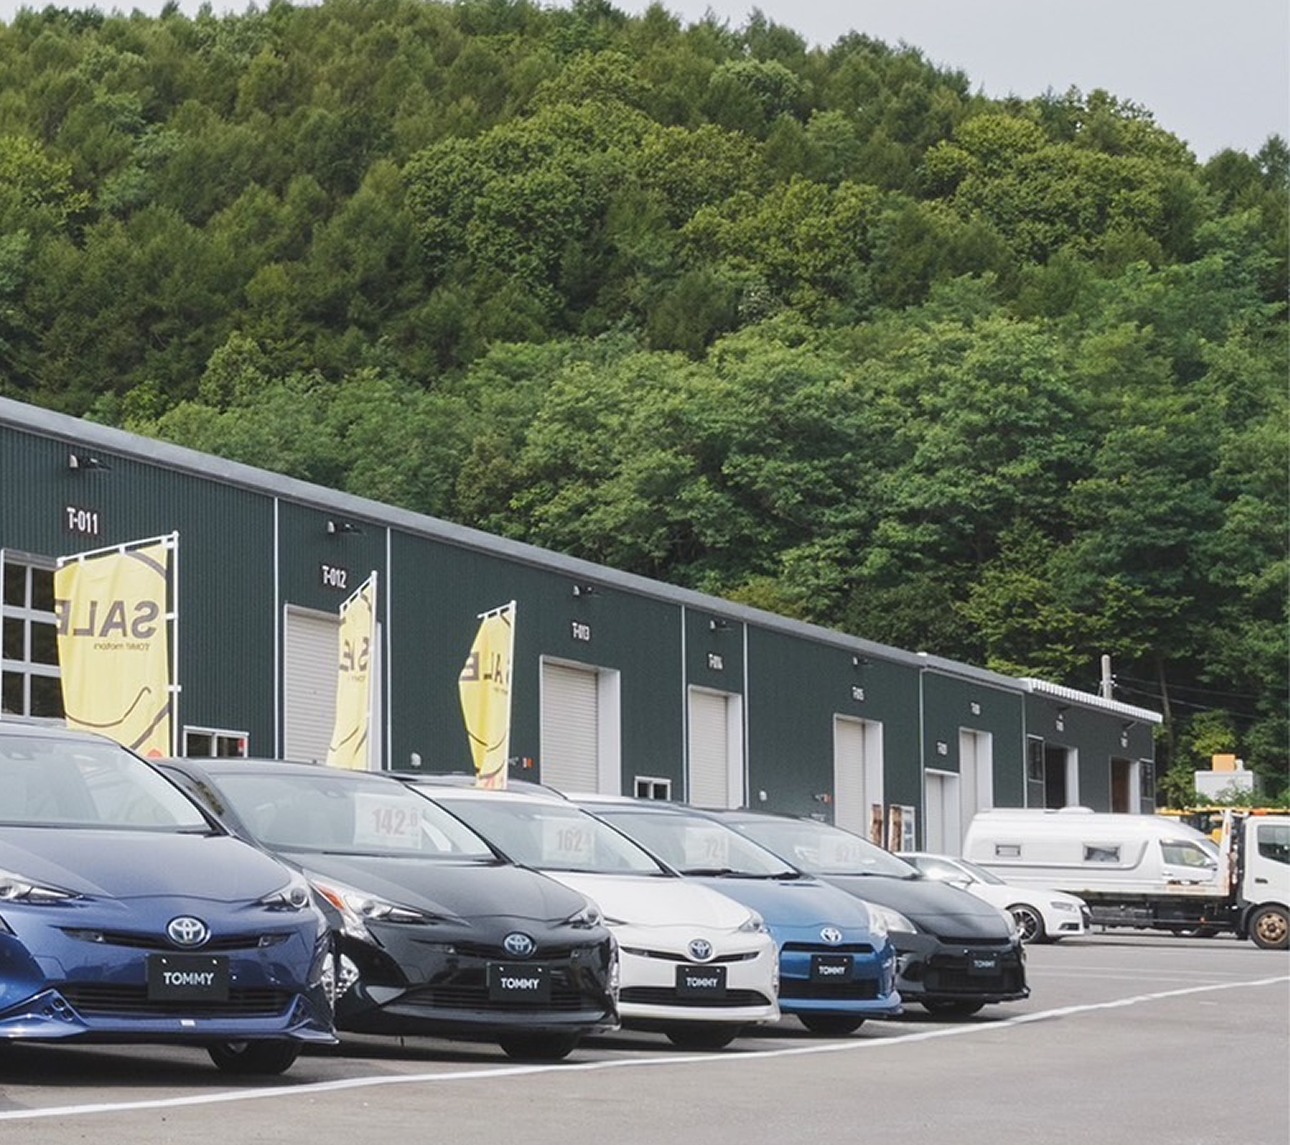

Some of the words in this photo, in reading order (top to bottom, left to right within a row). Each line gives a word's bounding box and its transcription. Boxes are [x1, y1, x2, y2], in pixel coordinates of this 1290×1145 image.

[67, 507, 98, 534] T-011
[322, 565, 347, 588] T-012
[162, 972, 214, 985] TOMMY
[500, 977, 540, 990] TOMMY
[686, 977, 718, 988] TOMMY
